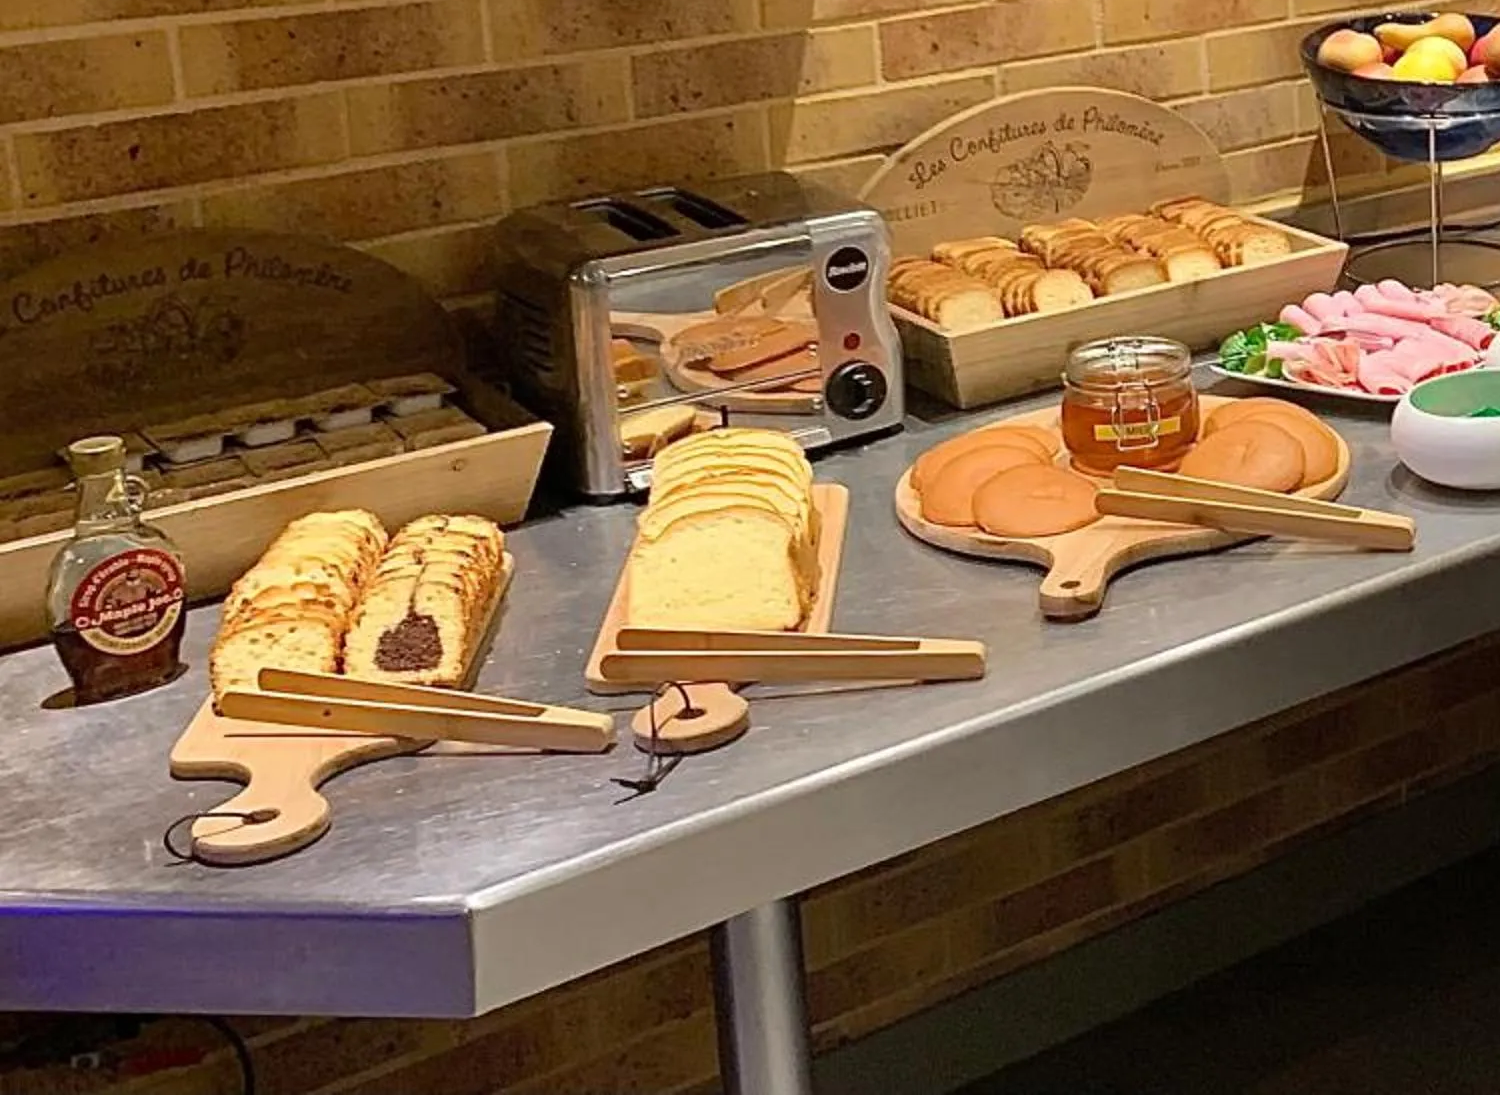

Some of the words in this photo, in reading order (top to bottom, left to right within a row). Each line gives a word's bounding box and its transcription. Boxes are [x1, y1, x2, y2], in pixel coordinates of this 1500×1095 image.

[908, 159, 947, 190] Les
[949, 120, 1047, 162] Confitures
[1052, 112, 1075, 132] de
[179, 257, 212, 281] de
